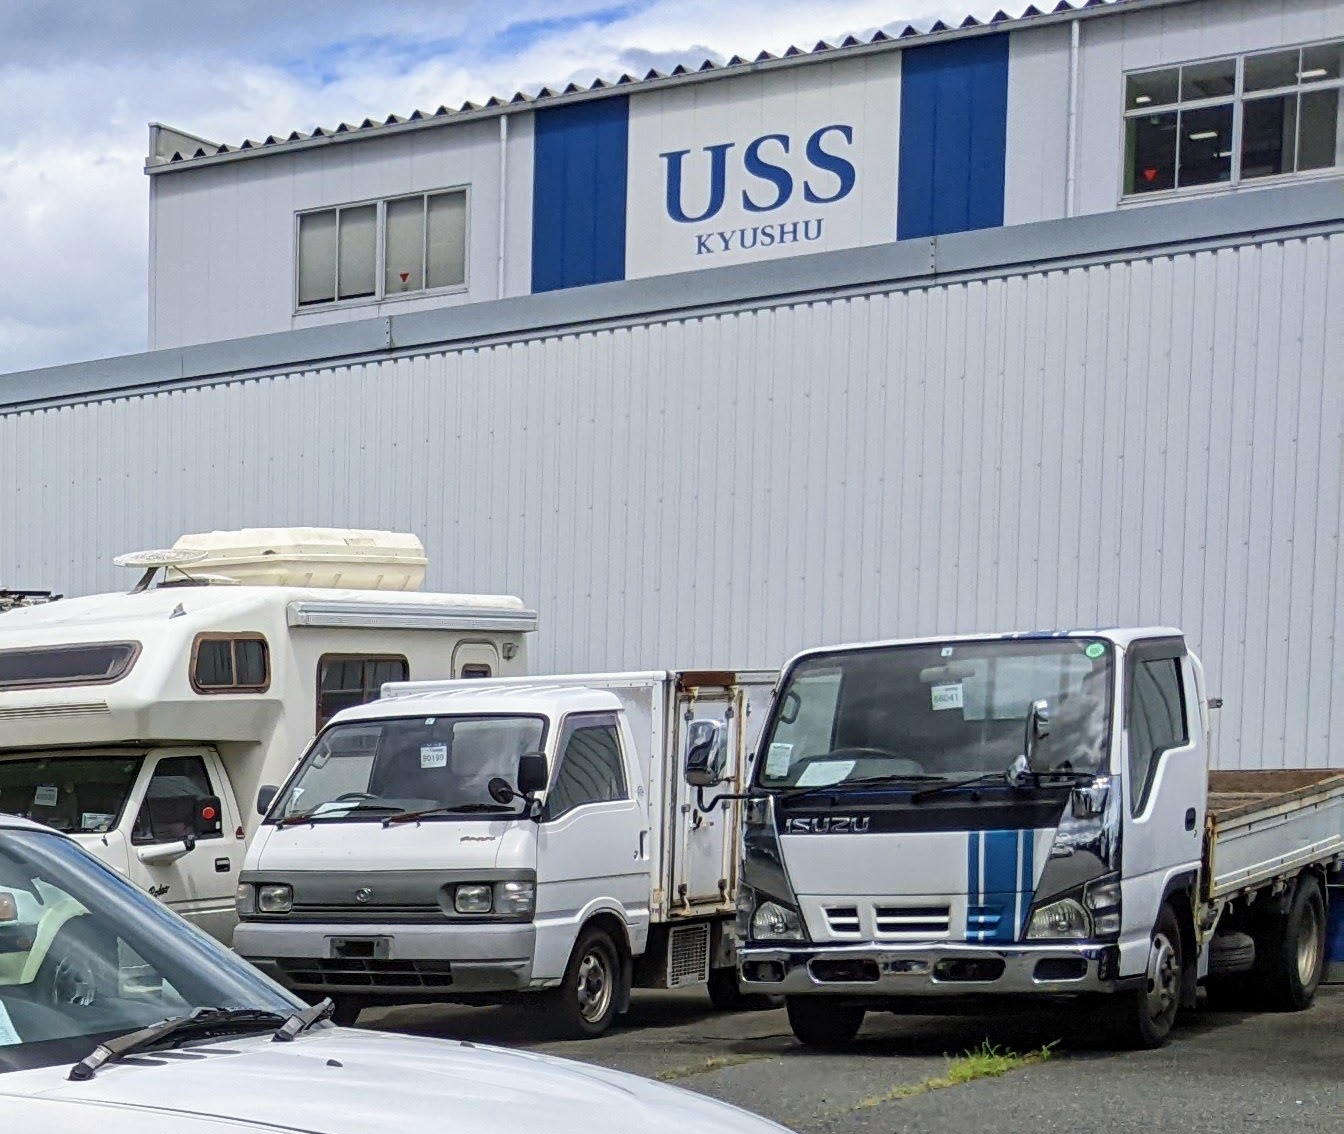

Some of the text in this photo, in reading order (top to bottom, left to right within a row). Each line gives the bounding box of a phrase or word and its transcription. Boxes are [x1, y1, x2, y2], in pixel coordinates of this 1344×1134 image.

[658, 124, 857, 224] USS
[695, 218, 825, 255] KYUSHU
[785, 816, 870, 833] ISUZU
